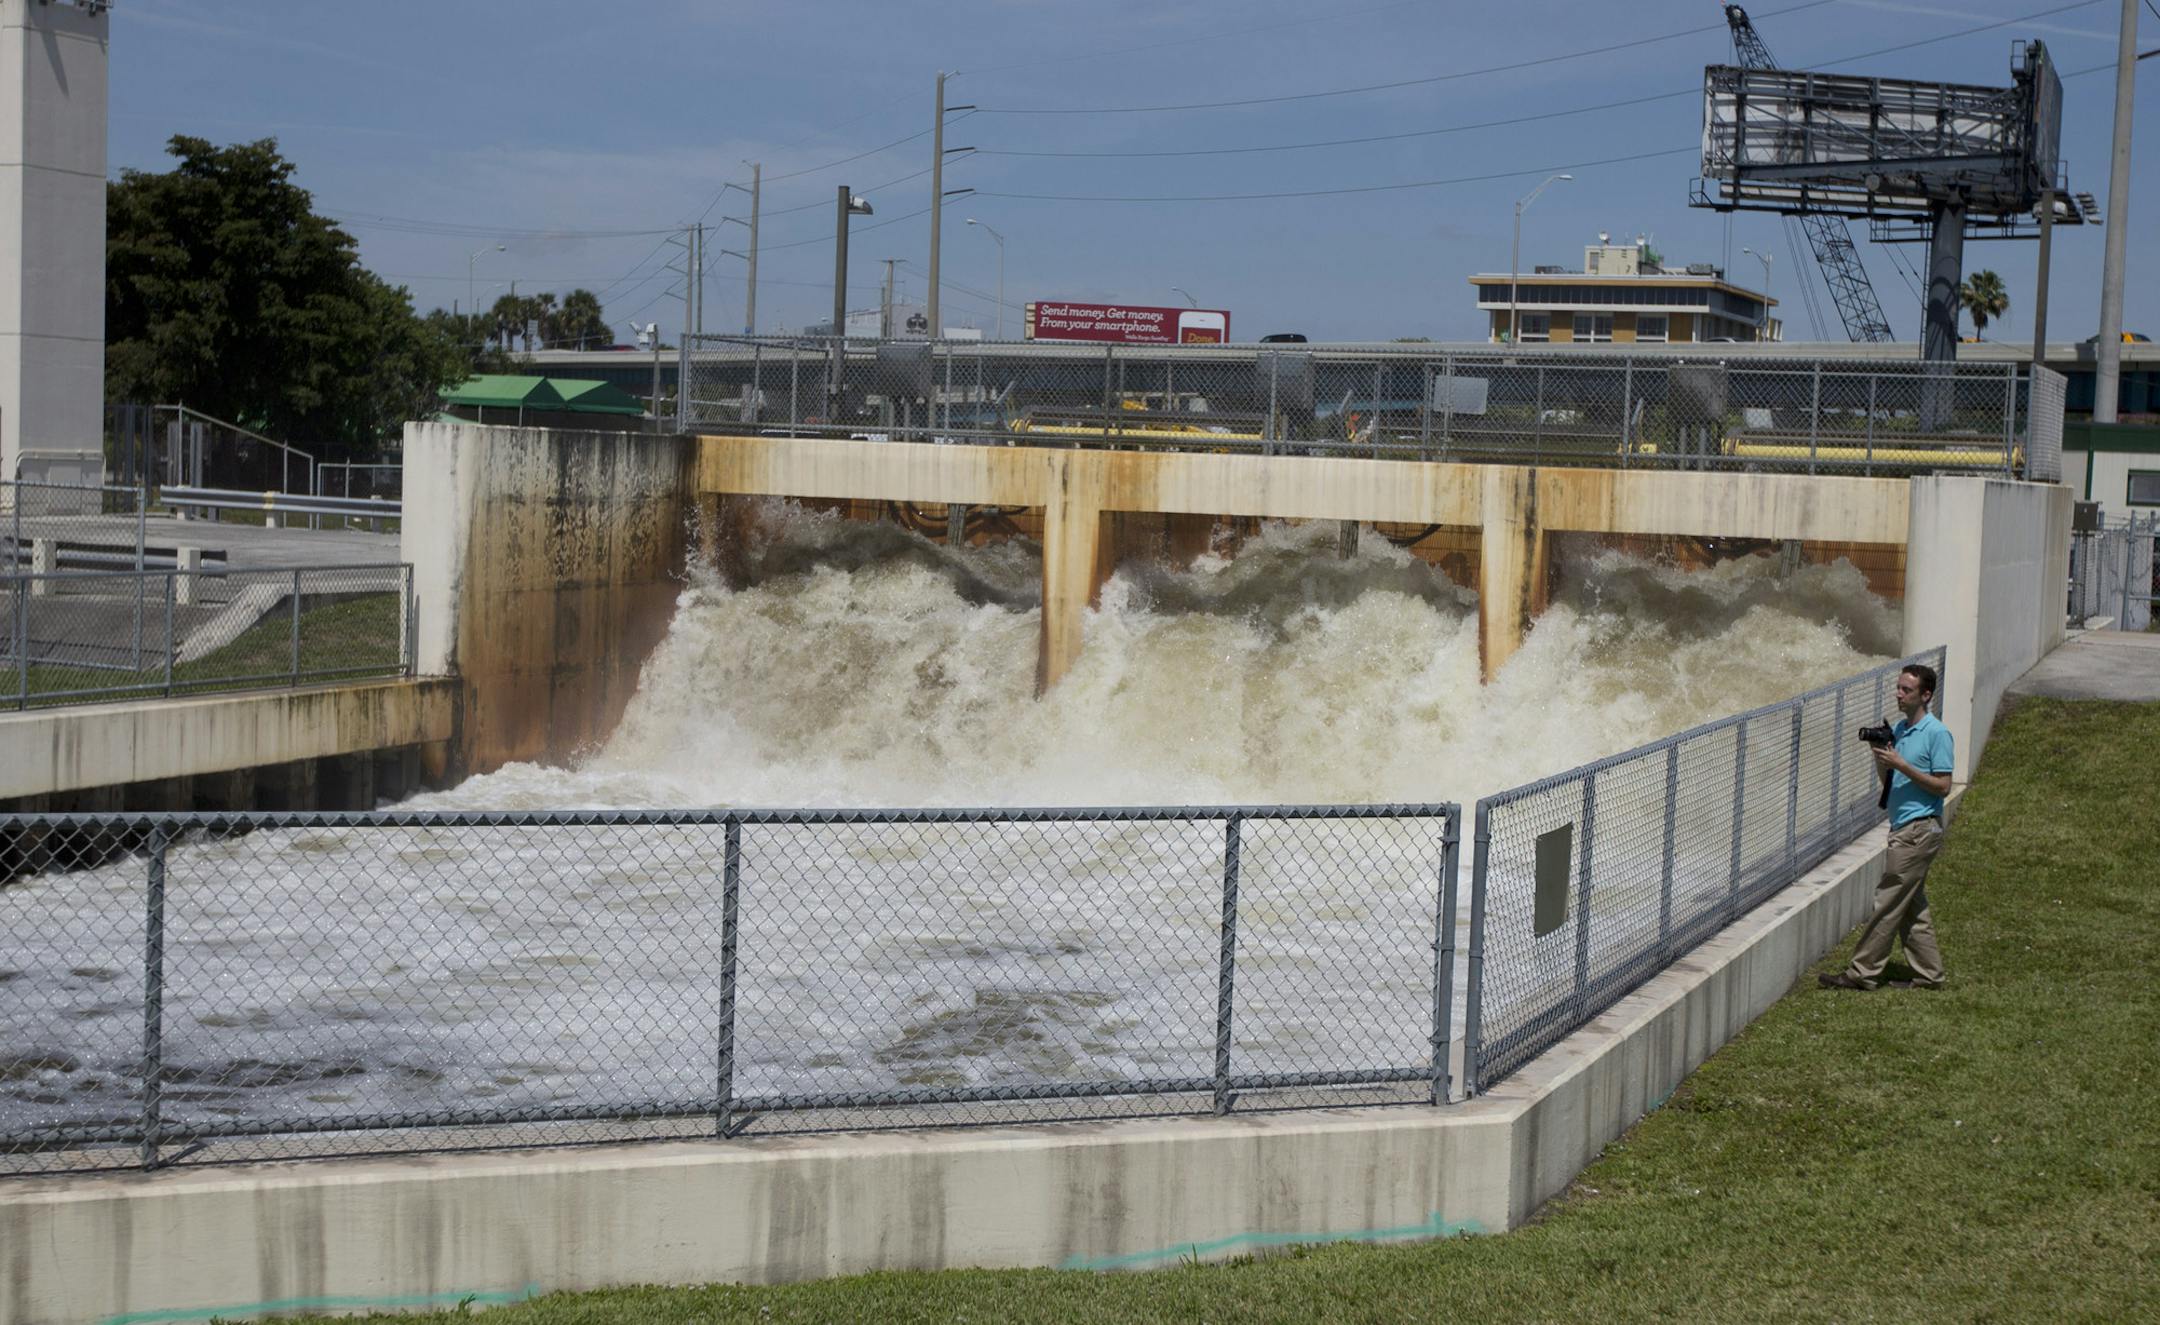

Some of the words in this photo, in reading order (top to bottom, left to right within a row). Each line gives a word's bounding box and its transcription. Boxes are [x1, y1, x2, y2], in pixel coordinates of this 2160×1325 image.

[1040, 304, 1068, 316] Send
[1069, 309, 1105, 320] money.
[1107, 308, 1127, 318] Get
[1128, 312, 1164, 323] money.
[1040, 317, 1067, 328] From
[1067, 320, 1093, 331] your
[1094, 321, 1161, 333] smartphone.
